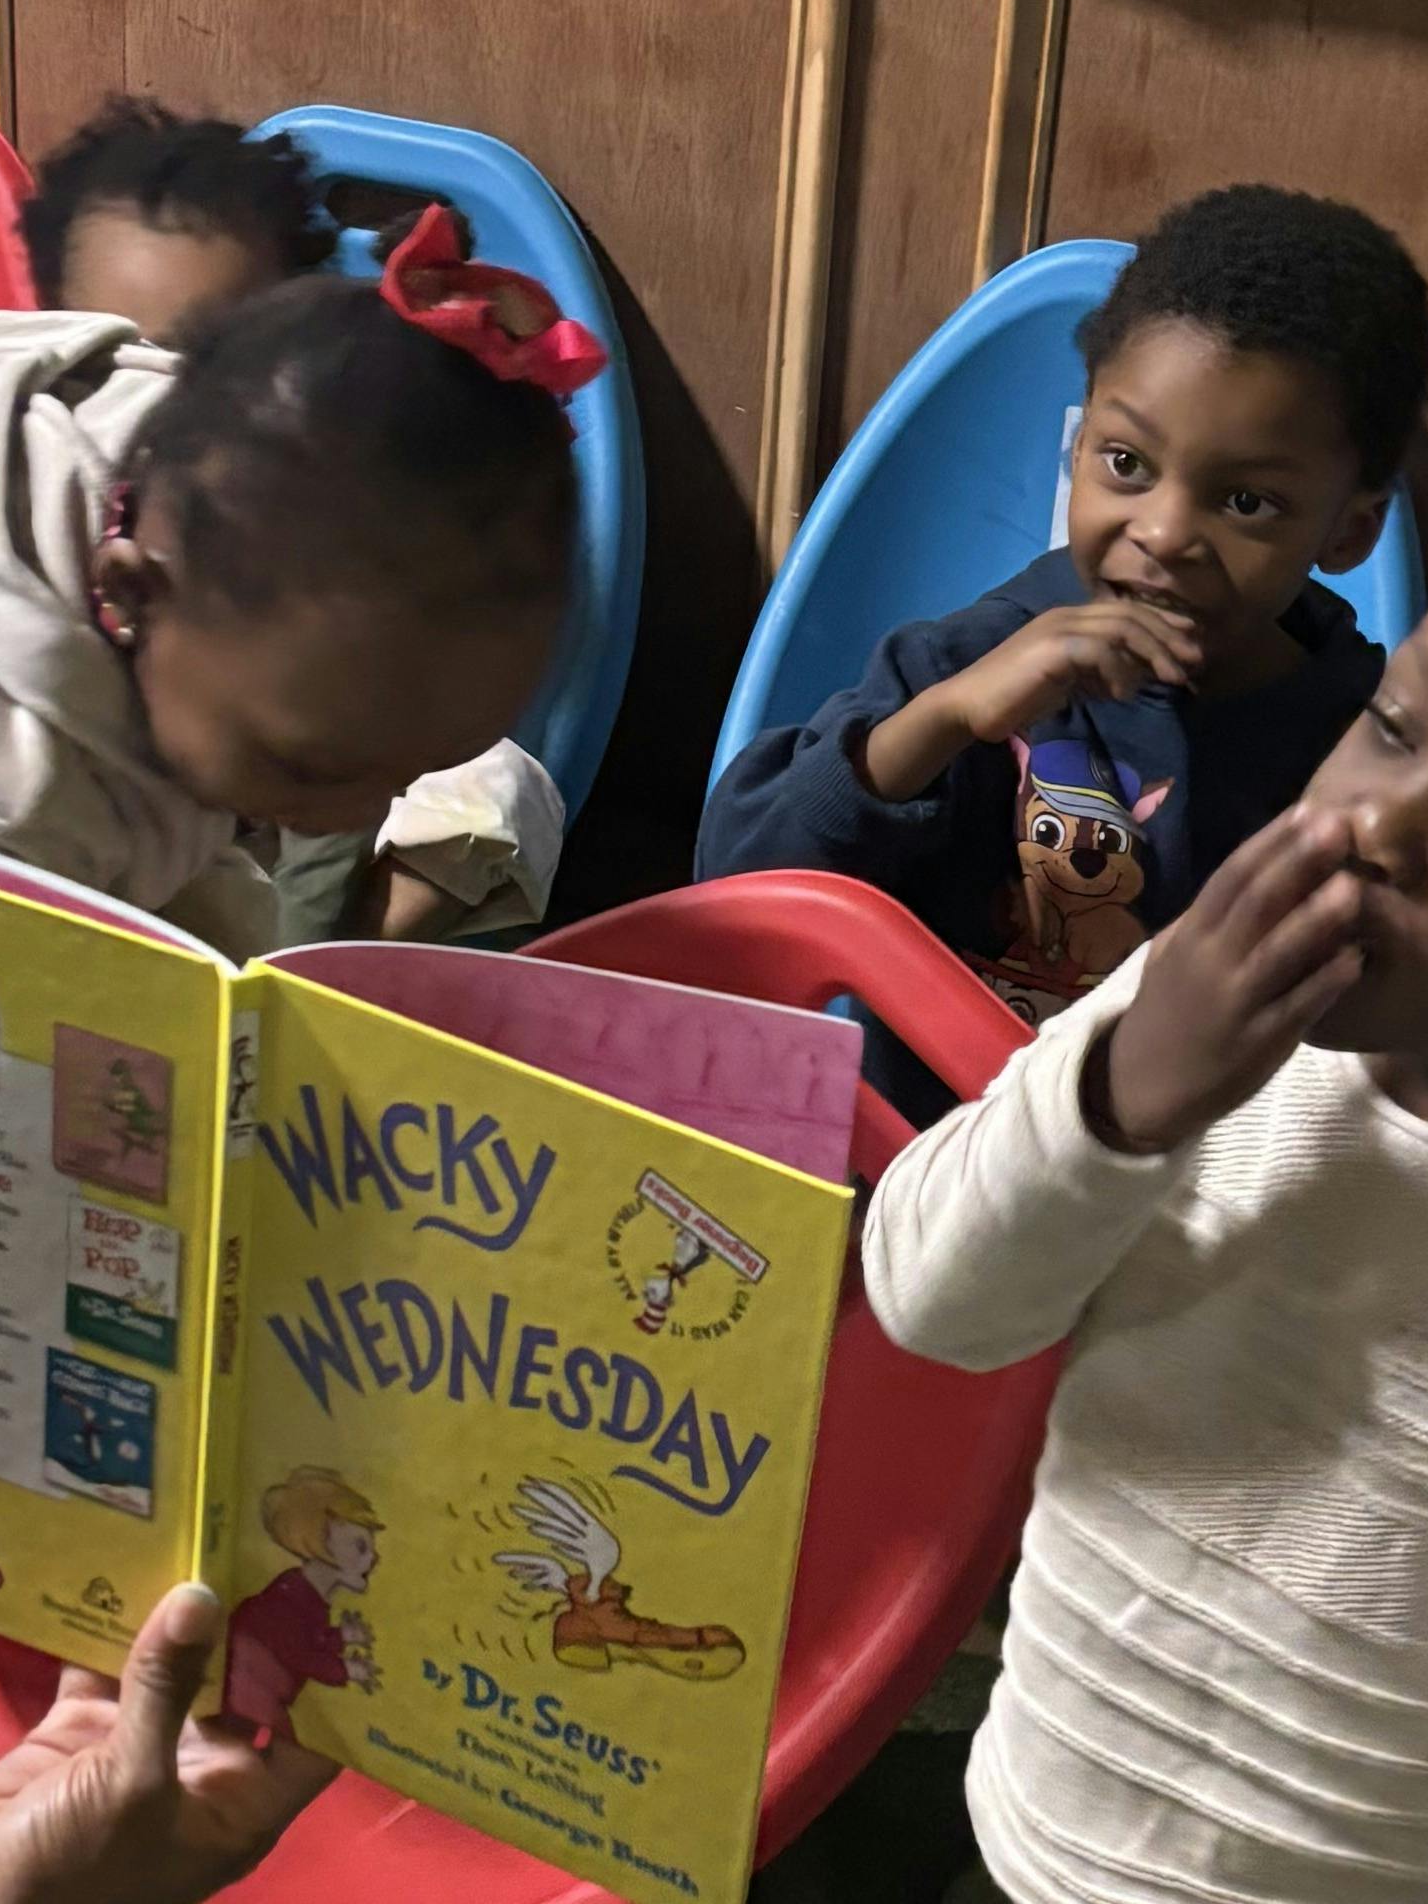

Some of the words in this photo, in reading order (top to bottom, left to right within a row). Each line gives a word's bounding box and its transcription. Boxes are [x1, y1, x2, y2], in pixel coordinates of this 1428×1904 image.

[258, 1084, 557, 1253] WACKY
[644, 1176, 692, 1221] Books
[693, 1216, 761, 1275] Beginner
[267, 1276, 772, 1516] WEDNESDAY
[459, 1662, 524, 1726] Dr.
[532, 1693, 649, 1786] Seuss
